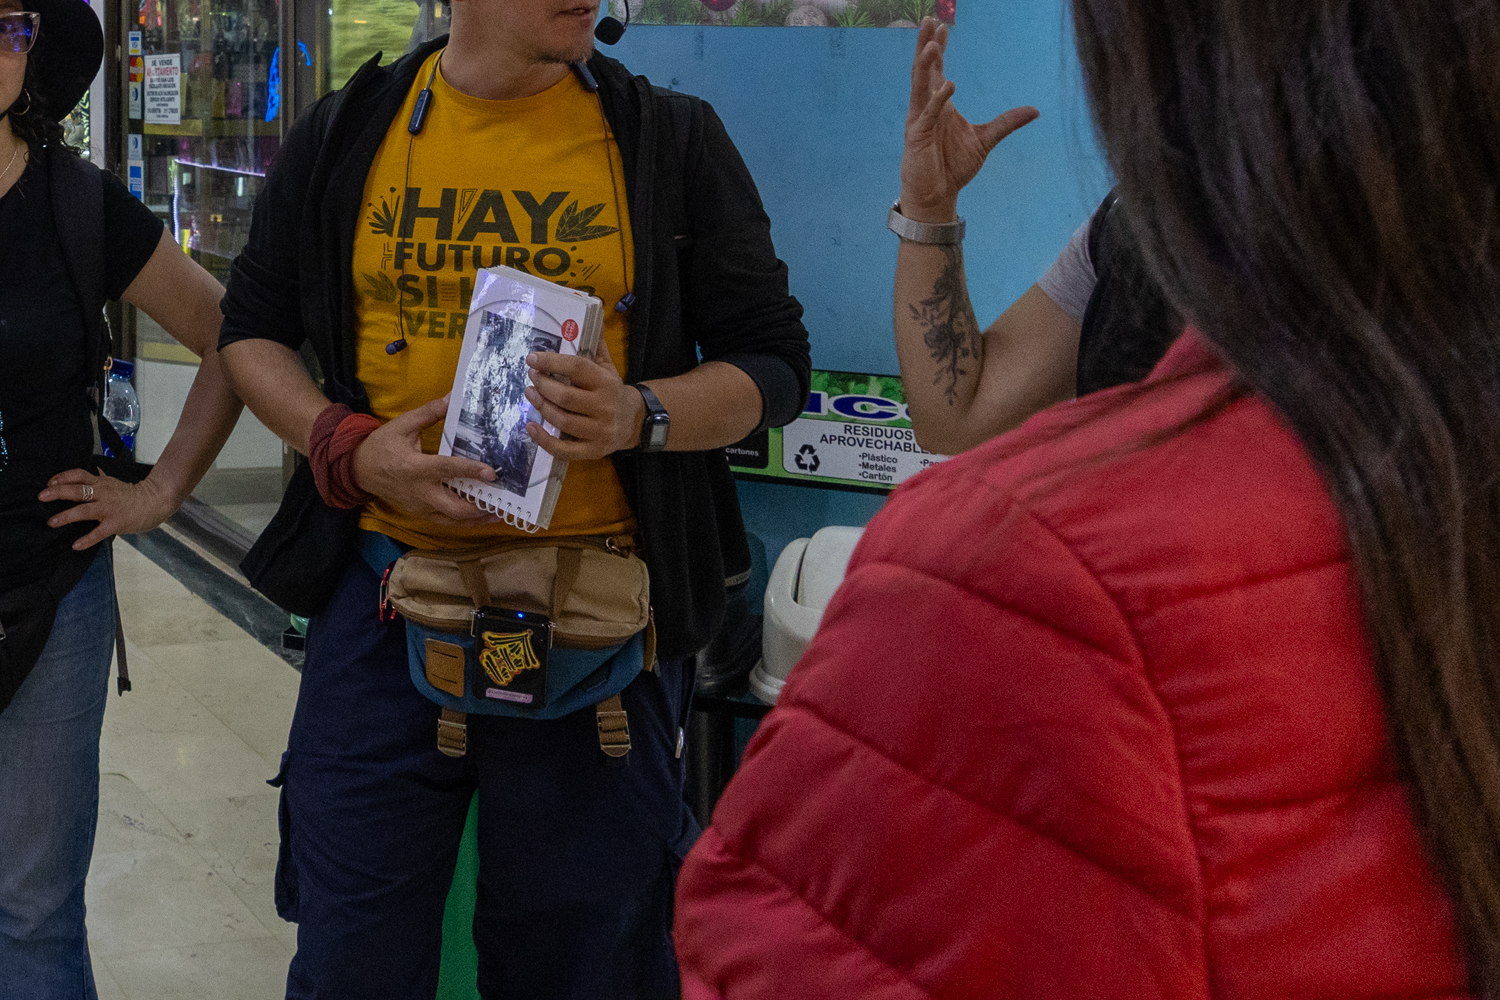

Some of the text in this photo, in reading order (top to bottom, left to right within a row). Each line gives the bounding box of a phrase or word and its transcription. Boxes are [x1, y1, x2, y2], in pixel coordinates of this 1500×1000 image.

[397, 187, 571, 245] HAY
[394, 242, 571, 276] FUTURO
[396, 274, 438, 308] SI
[402, 310, 469, 340] VER
[844, 424, 913, 441] RESIDUOS
[725, 447, 759, 457] cartones
[819, 434, 930, 455] APROVECHABL
[861, 452, 898, 463] Plástico
[861, 462, 897, 473] Metales
[861, 471, 893, 482] Cartón
